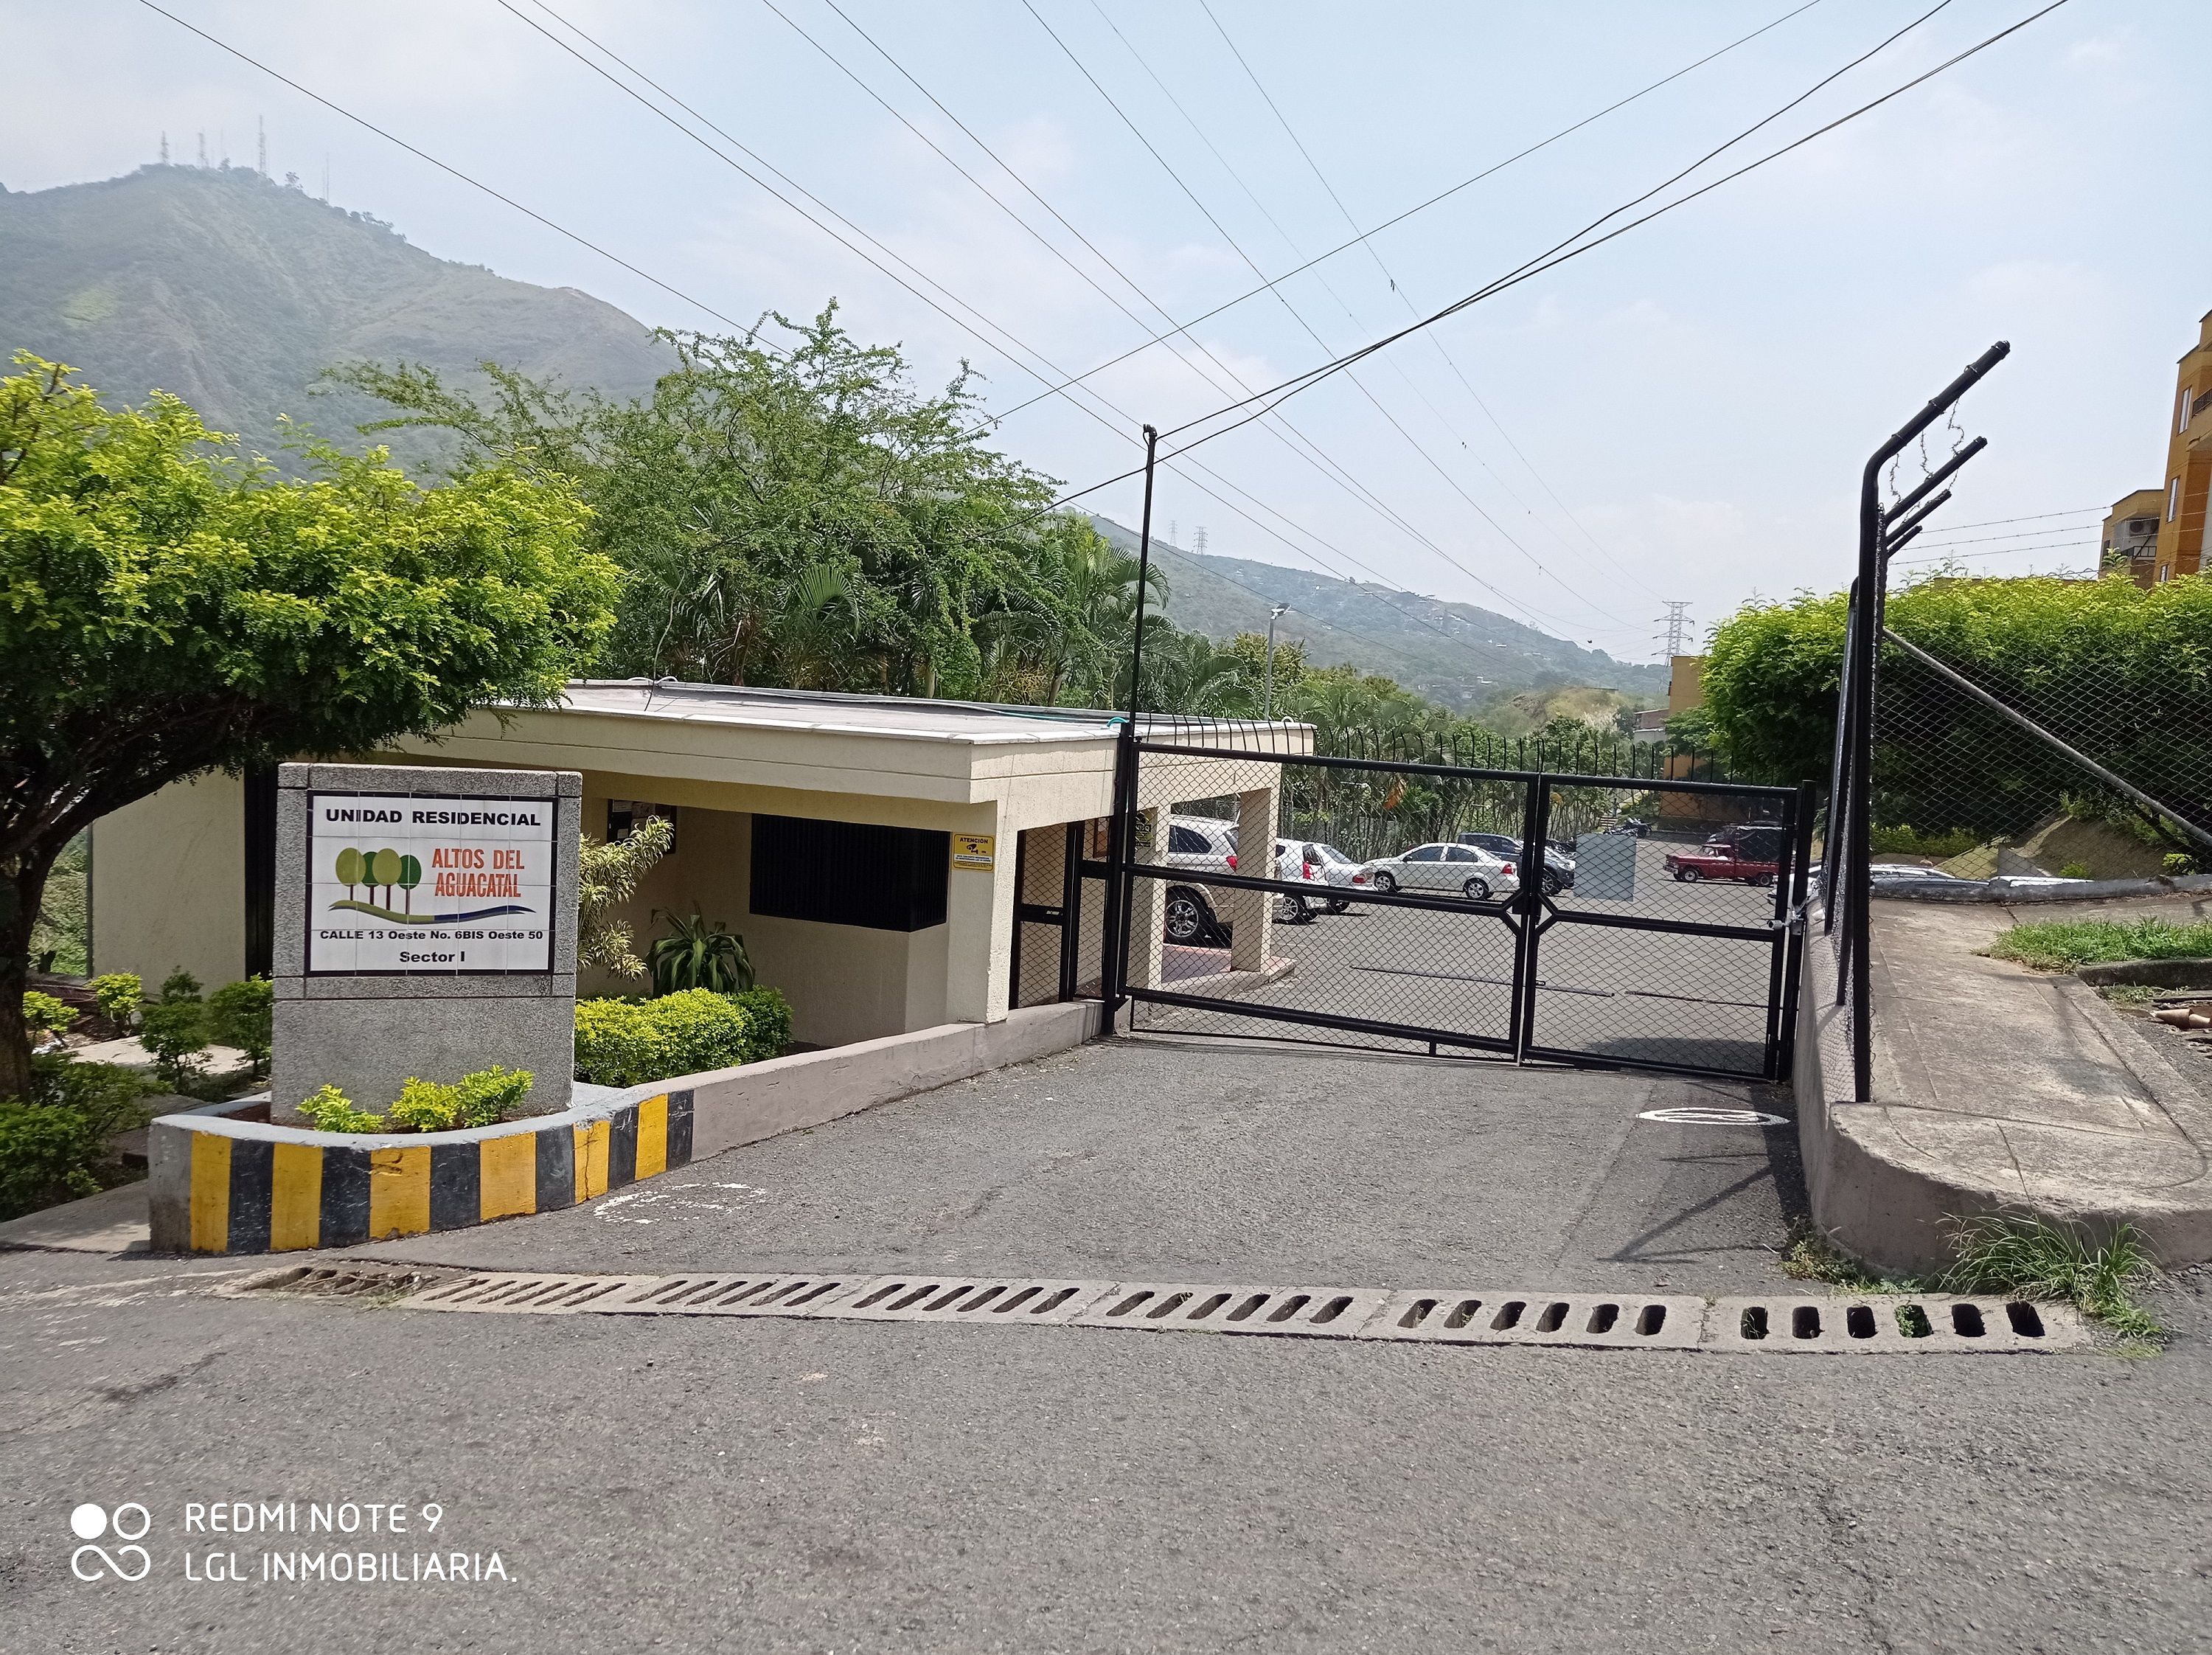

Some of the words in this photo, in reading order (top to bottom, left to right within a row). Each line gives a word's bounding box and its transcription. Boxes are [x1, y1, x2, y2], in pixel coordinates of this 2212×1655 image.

[326, 808, 403, 823] UNIDAD
[412, 811, 541, 827] RESIDENCIAL
[431, 848, 484, 869] ALTOS
[493, 849, 525, 870] DEL
[434, 872, 521, 898] AGUACATAL
[320, 930, 364, 940] CALLE
[368, 930, 384, 940] 13
[388, 930, 426, 940] Oeste
[430, 930, 451, 940] No.
[454, 930, 484, 940] 6BIS
[488, 930, 525, 940] Oeste
[528, 930, 543, 940] 50
[399, 951, 456, 962] Sector
[460, 951, 466, 962] I
